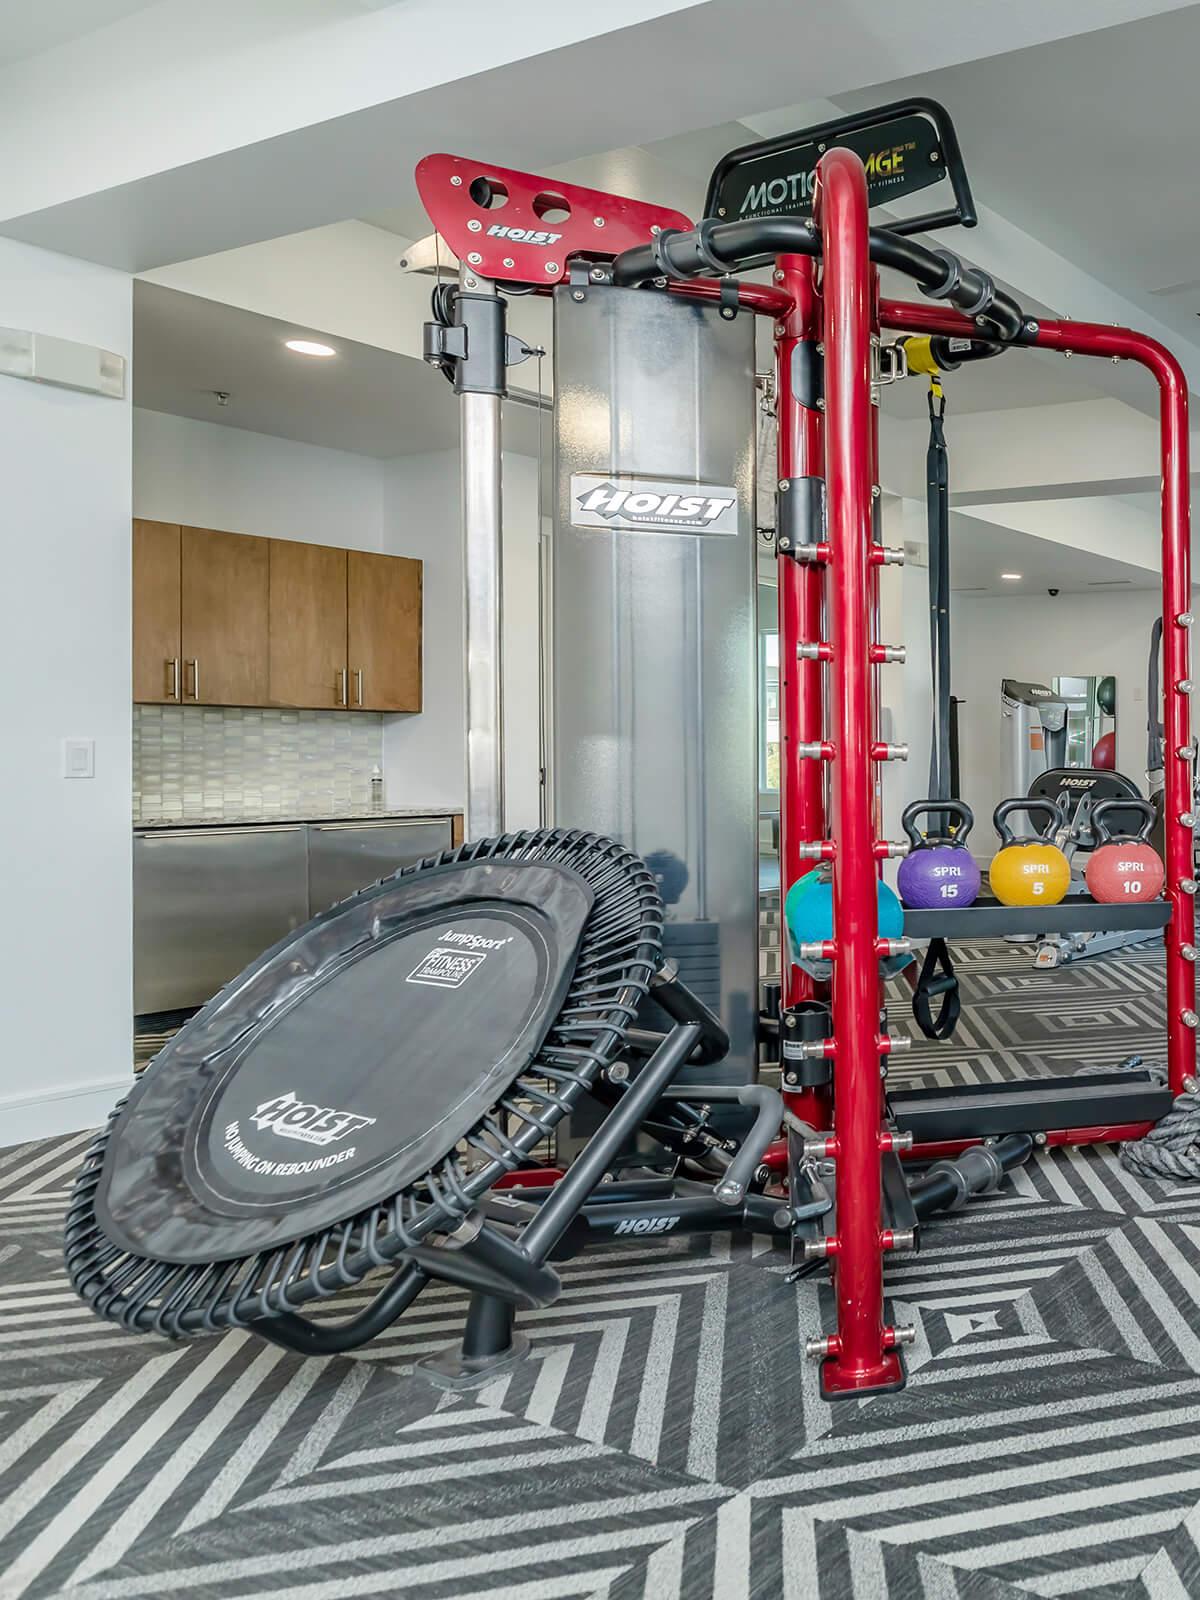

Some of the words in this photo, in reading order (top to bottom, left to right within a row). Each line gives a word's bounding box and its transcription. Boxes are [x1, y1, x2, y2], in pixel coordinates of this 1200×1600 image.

[878, 176, 905, 188] FITNESS
[486, 224, 563, 245] HOIST
[582, 489, 735, 520] HOIST
[1059, 777, 1097, 787] HOIST
[933, 866, 961, 877] SPRI
[1023, 864, 1050, 875] SPRI
[1117, 861, 1145, 872] SPRI
[940, 884, 958, 898] 15
[1032, 882, 1044, 895] 5
[1123, 880, 1142, 894] 10
[425, 955, 476, 972] FITNESS
[252, 1097, 371, 1140] HOIST
[225, 1120, 240, 1140] NO
[224, 1135, 261, 1170] JUMPING
[254, 1160, 277, 1175] ON
[271, 1147, 356, 1176] REBOUNDER
[614, 1216, 681, 1235] HOIST
